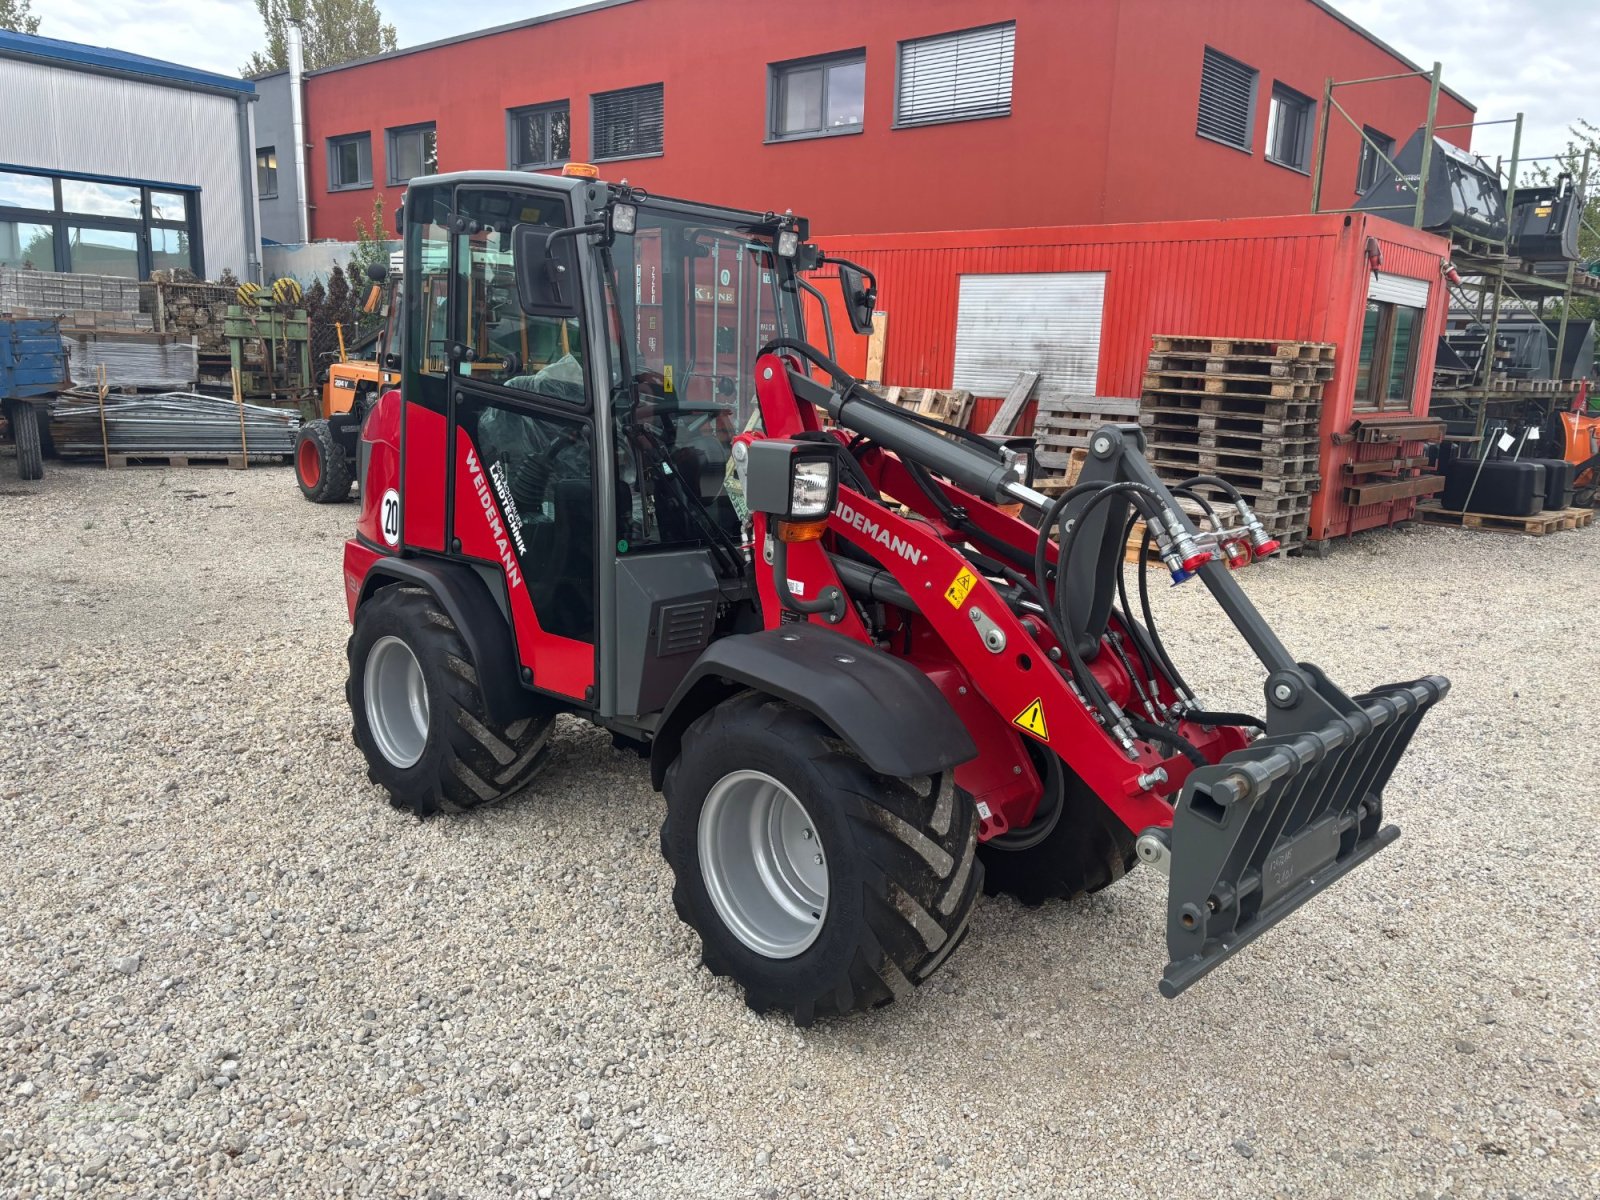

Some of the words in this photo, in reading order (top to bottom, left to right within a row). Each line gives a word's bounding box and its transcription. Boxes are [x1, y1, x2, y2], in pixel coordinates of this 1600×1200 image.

[707, 292, 733, 301] LNE
[385, 498, 398, 536] 20
[466, 448, 521, 588] WEIDEMANN
[489, 464, 527, 557] LANDTECHNIK
[495, 460, 523, 529] SCHLACHTBAUER
[830, 501, 921, 566] IDEMANN
